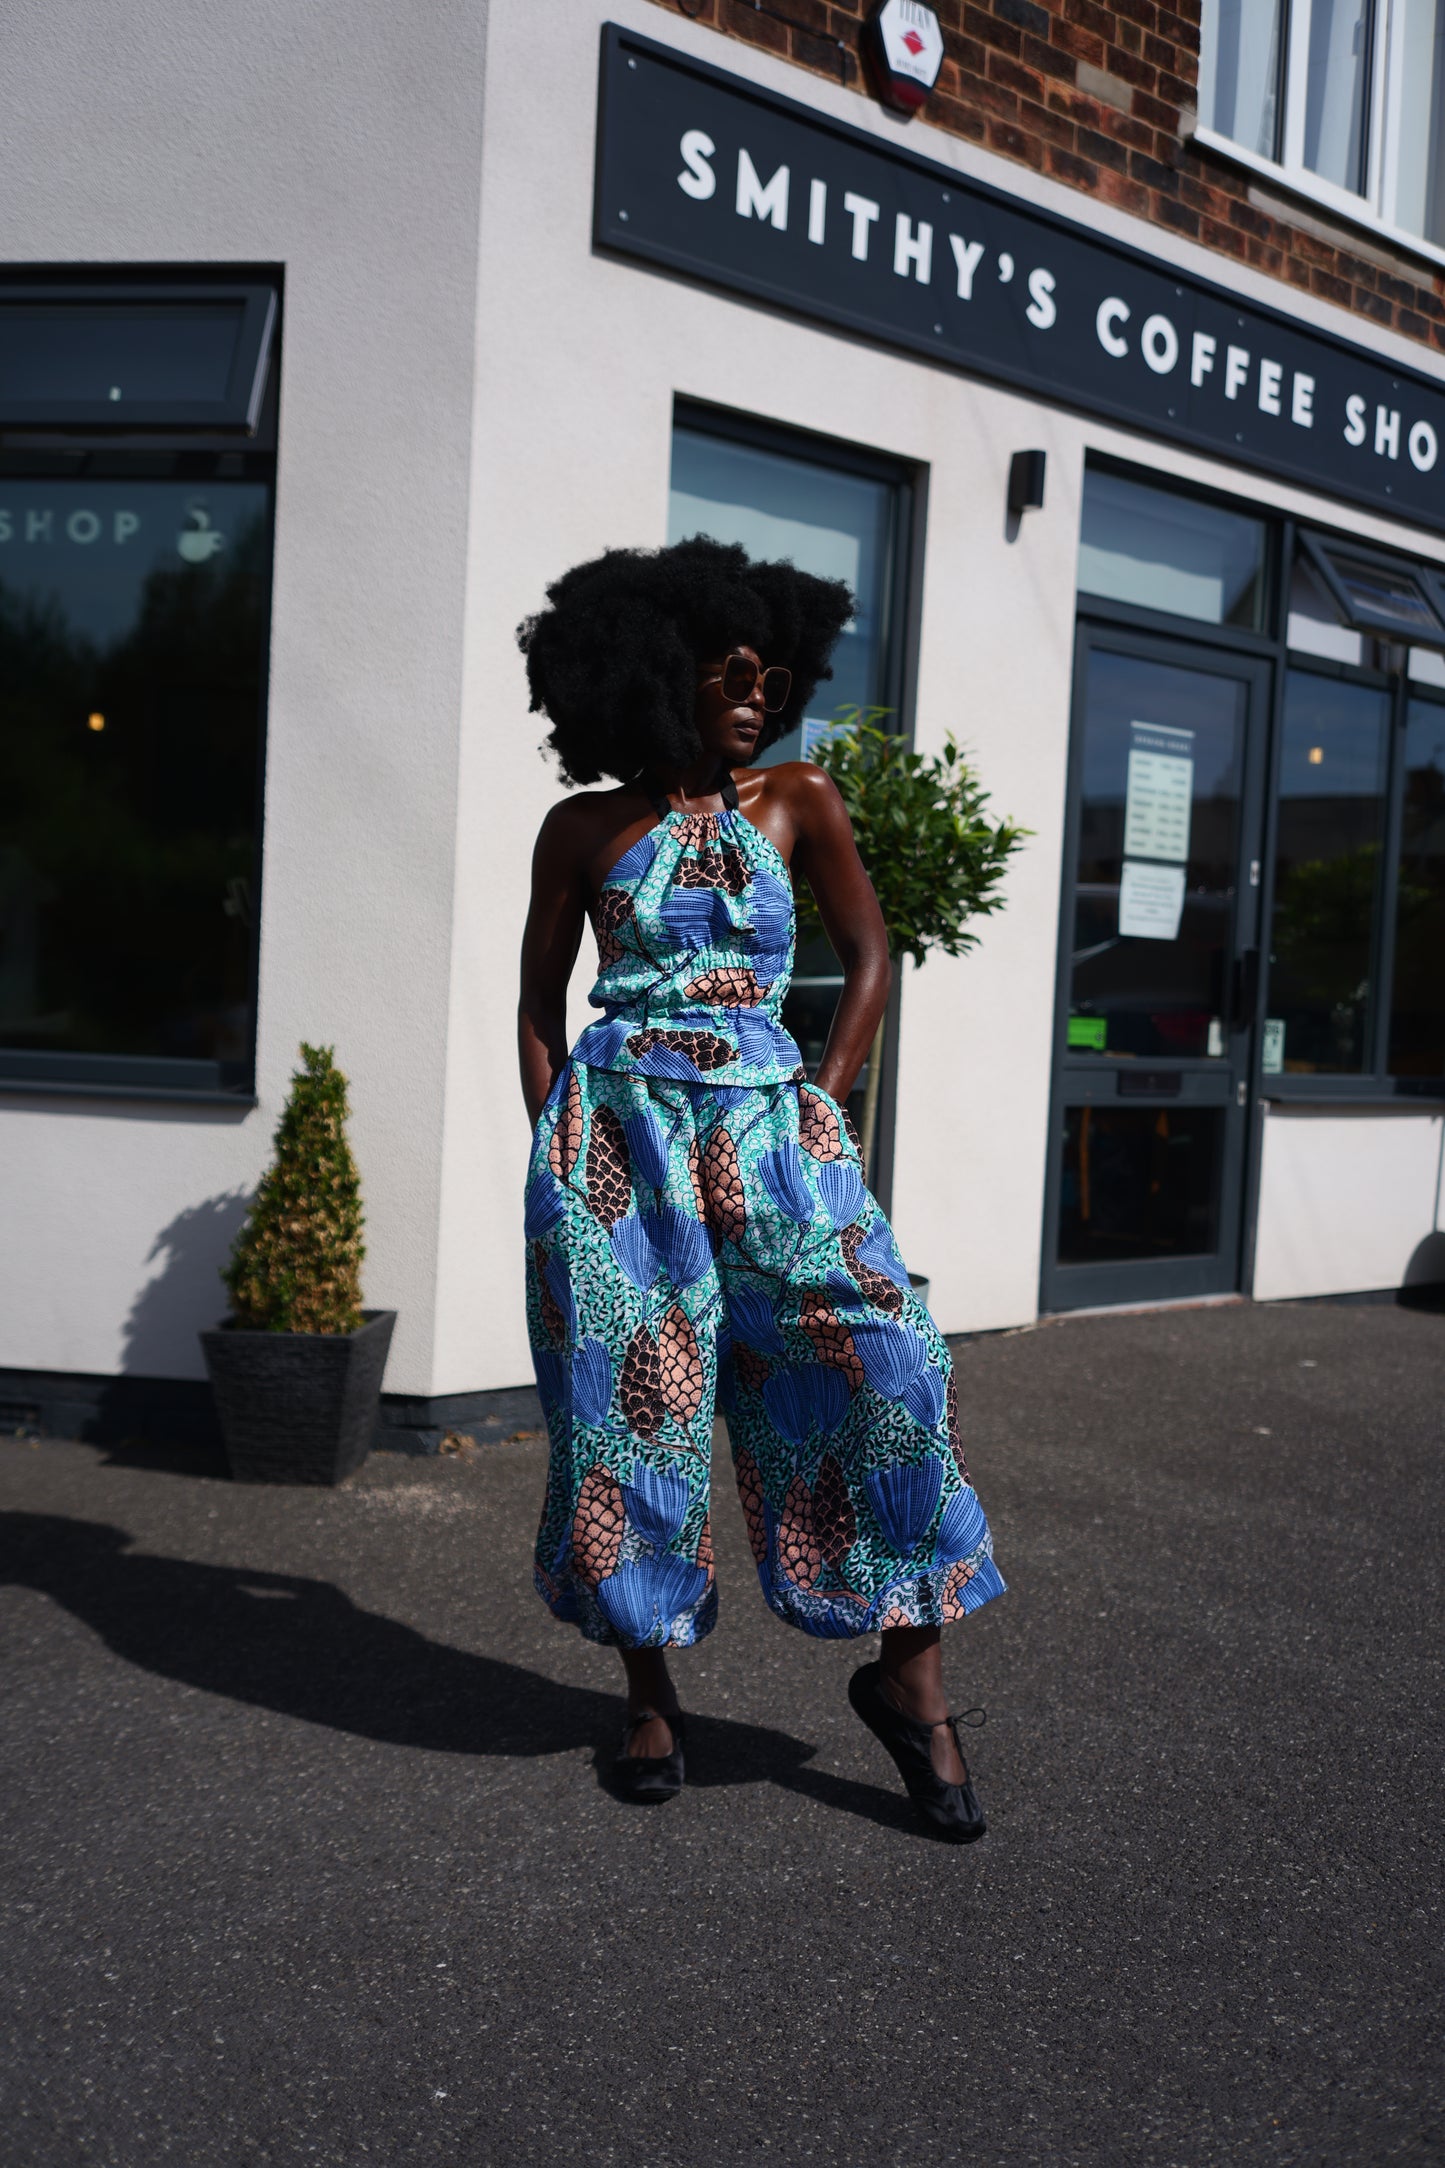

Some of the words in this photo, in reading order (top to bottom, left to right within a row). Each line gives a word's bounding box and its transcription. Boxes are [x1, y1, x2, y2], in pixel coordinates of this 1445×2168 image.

[677, 129, 1057, 330] SMITHY'S
[1096, 297, 1316, 428] COFFEE
[1343, 394, 1438, 472] SHO
